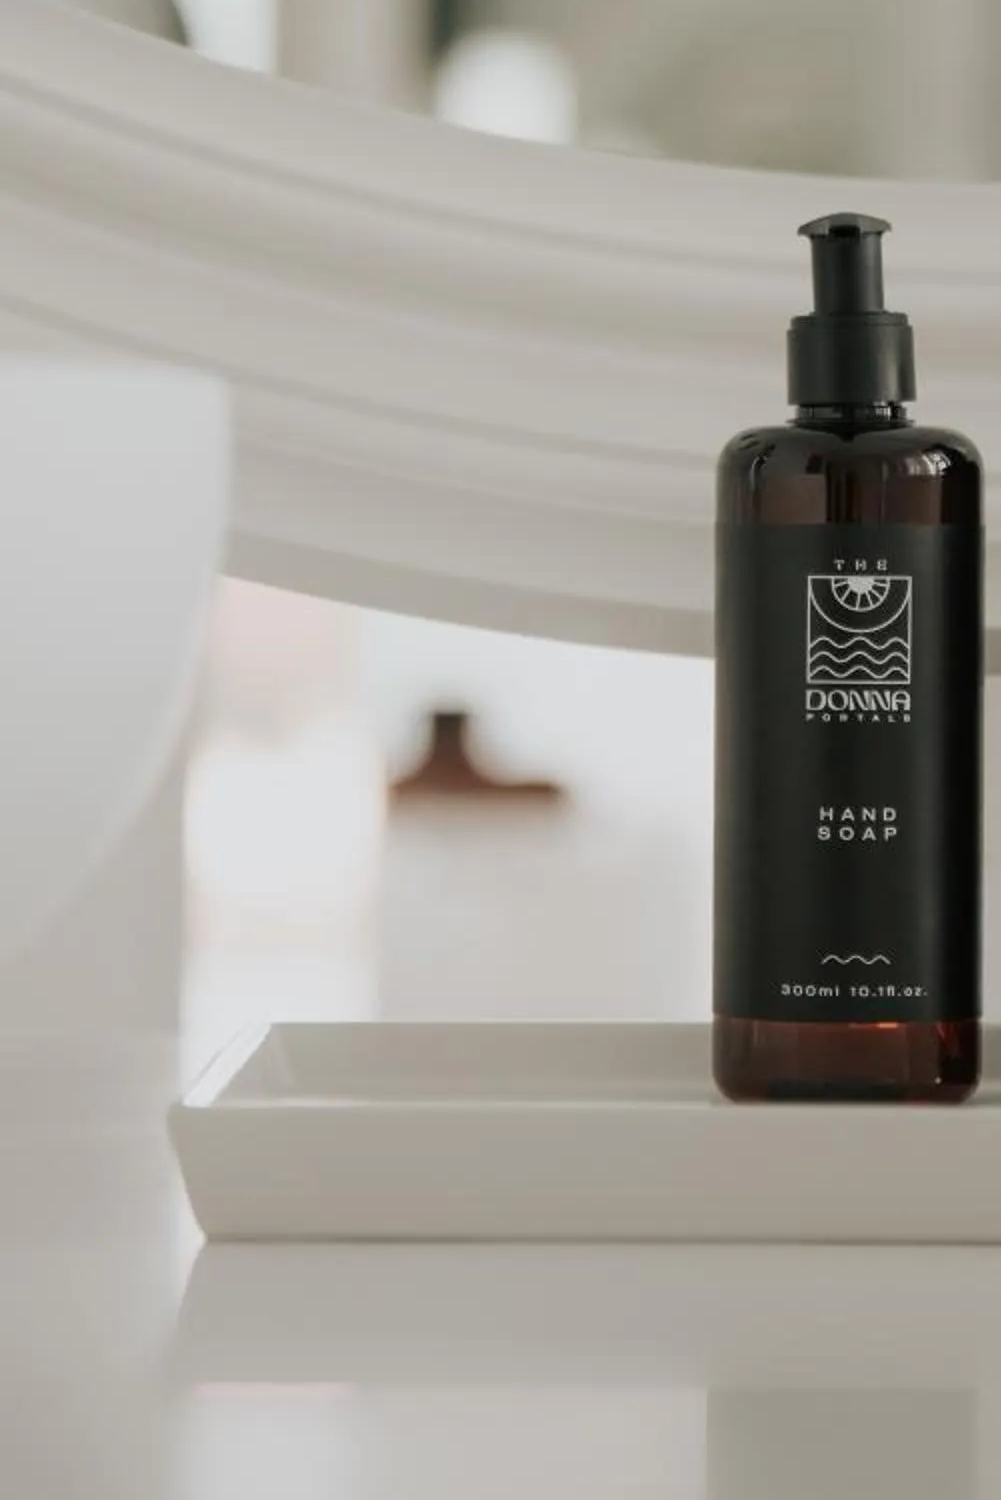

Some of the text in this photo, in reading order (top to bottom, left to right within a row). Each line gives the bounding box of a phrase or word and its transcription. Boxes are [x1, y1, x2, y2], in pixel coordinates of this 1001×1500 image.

[834, 558, 888, 572] THE
[806, 689, 911, 712] DONNA
[819, 806, 897, 822] HAND
[817, 826, 897, 842] SOAP
[780, 983, 840, 997] 300ml
